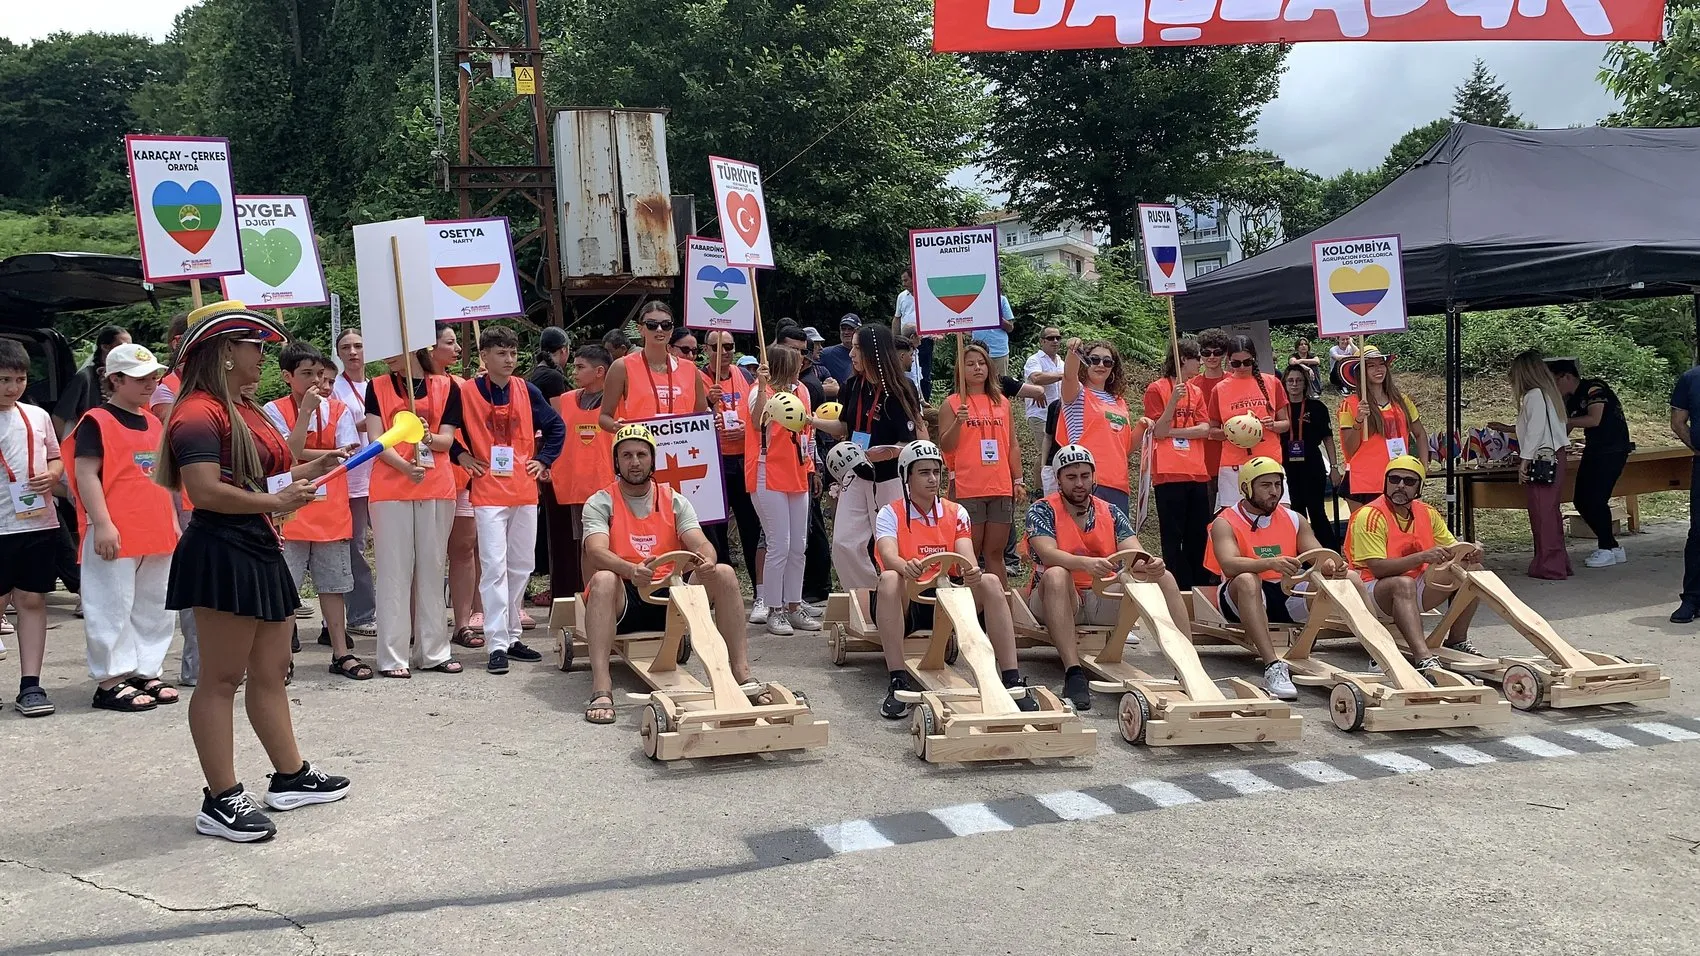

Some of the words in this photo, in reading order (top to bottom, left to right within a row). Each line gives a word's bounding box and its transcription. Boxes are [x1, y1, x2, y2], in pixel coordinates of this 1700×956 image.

[134, 150, 182, 164] KARAÇAY
[190, 152, 226, 164] ÇERKES
[716, 162, 758, 186] TÜRKİYE
[1148, 210, 1172, 222] RUSYA
[440, 228, 484, 239] OSETYA
[915, 232, 992, 248] BULGARİSTAN
[940, 245, 970, 254] ARATLİTSİ
[1322, 240, 1391, 256] KOLOMBİYA
[832, 450, 860, 473] RUBA
[1060, 452, 1091, 466] RUBA
